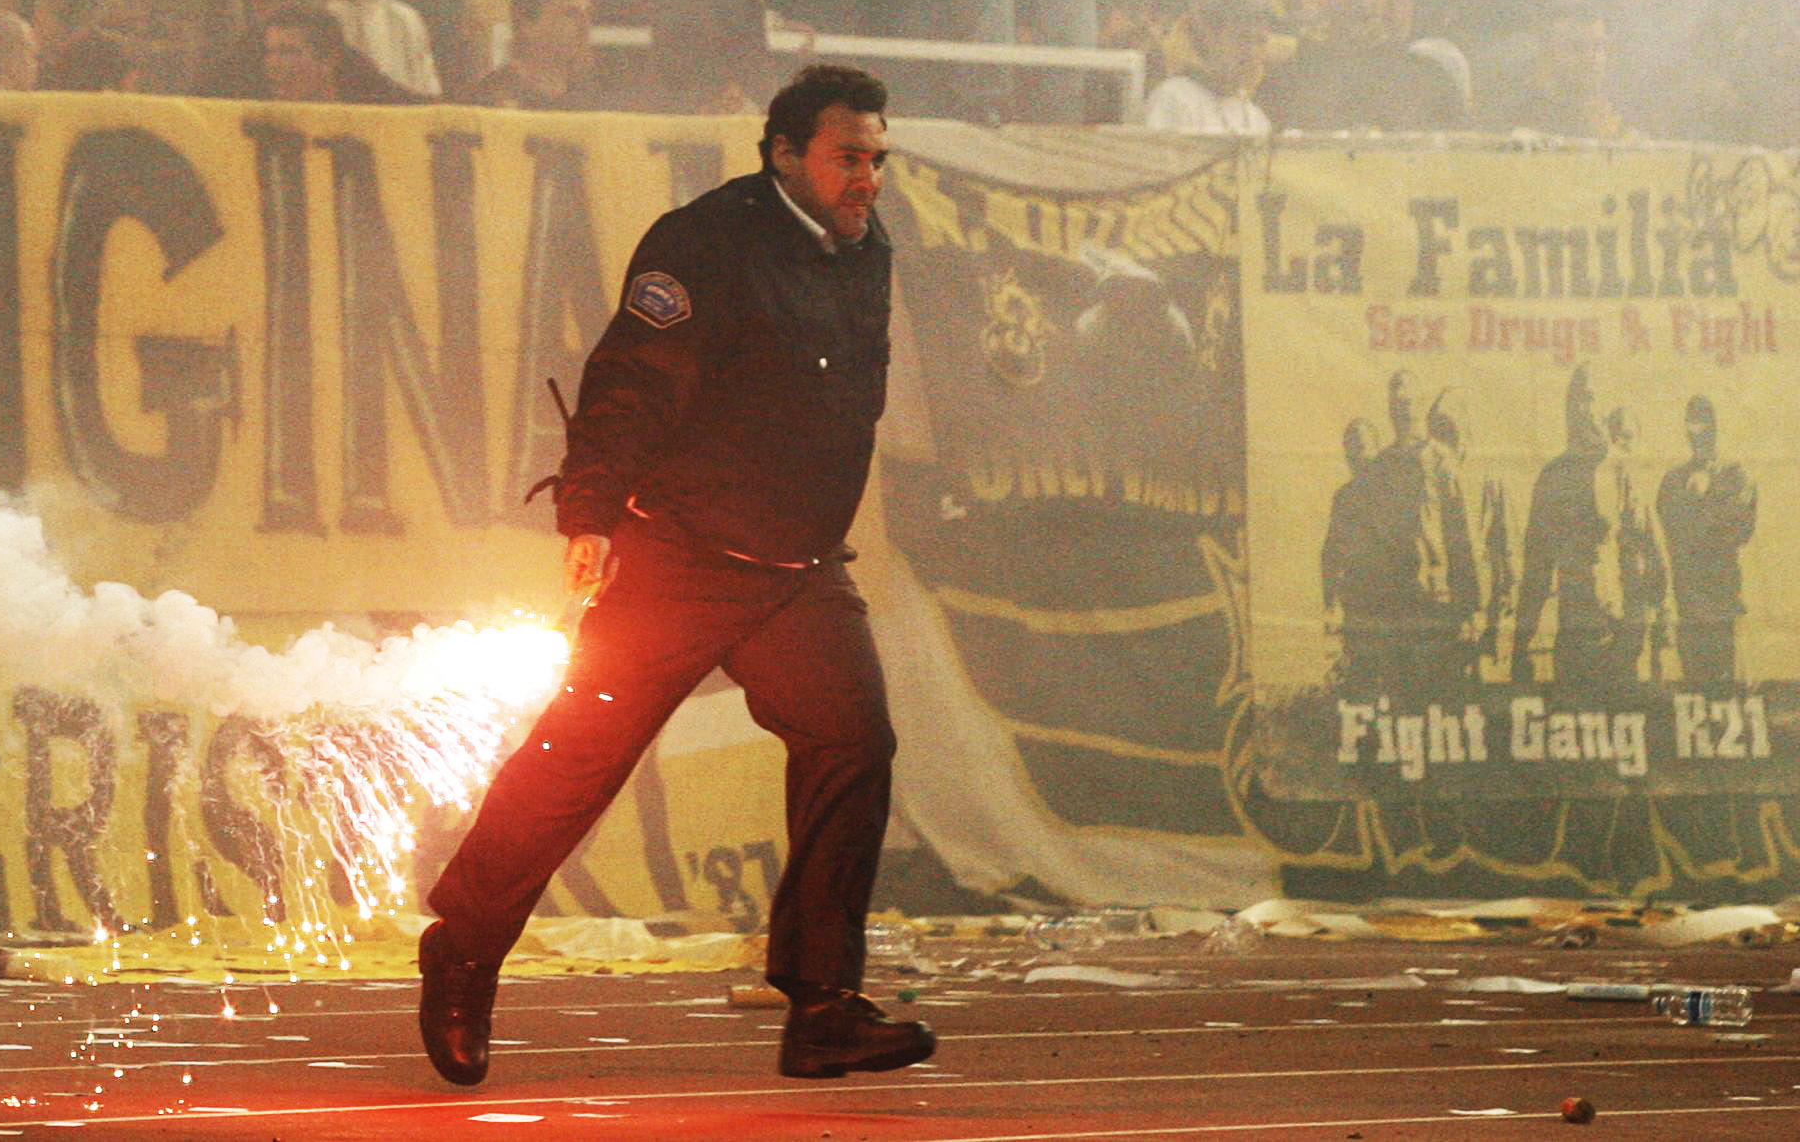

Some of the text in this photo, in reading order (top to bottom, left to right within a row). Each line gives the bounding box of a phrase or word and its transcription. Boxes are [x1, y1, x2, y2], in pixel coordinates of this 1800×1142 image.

[1255, 192, 1364, 295] La
[1406, 189, 1739, 298] Familia
[1366, 304, 1448, 352] Sex
[1468, 305, 1601, 364] Drugs
[1671, 302, 1778, 366] Fight
[1337, 692, 1772, 781] Fight Gang R21
